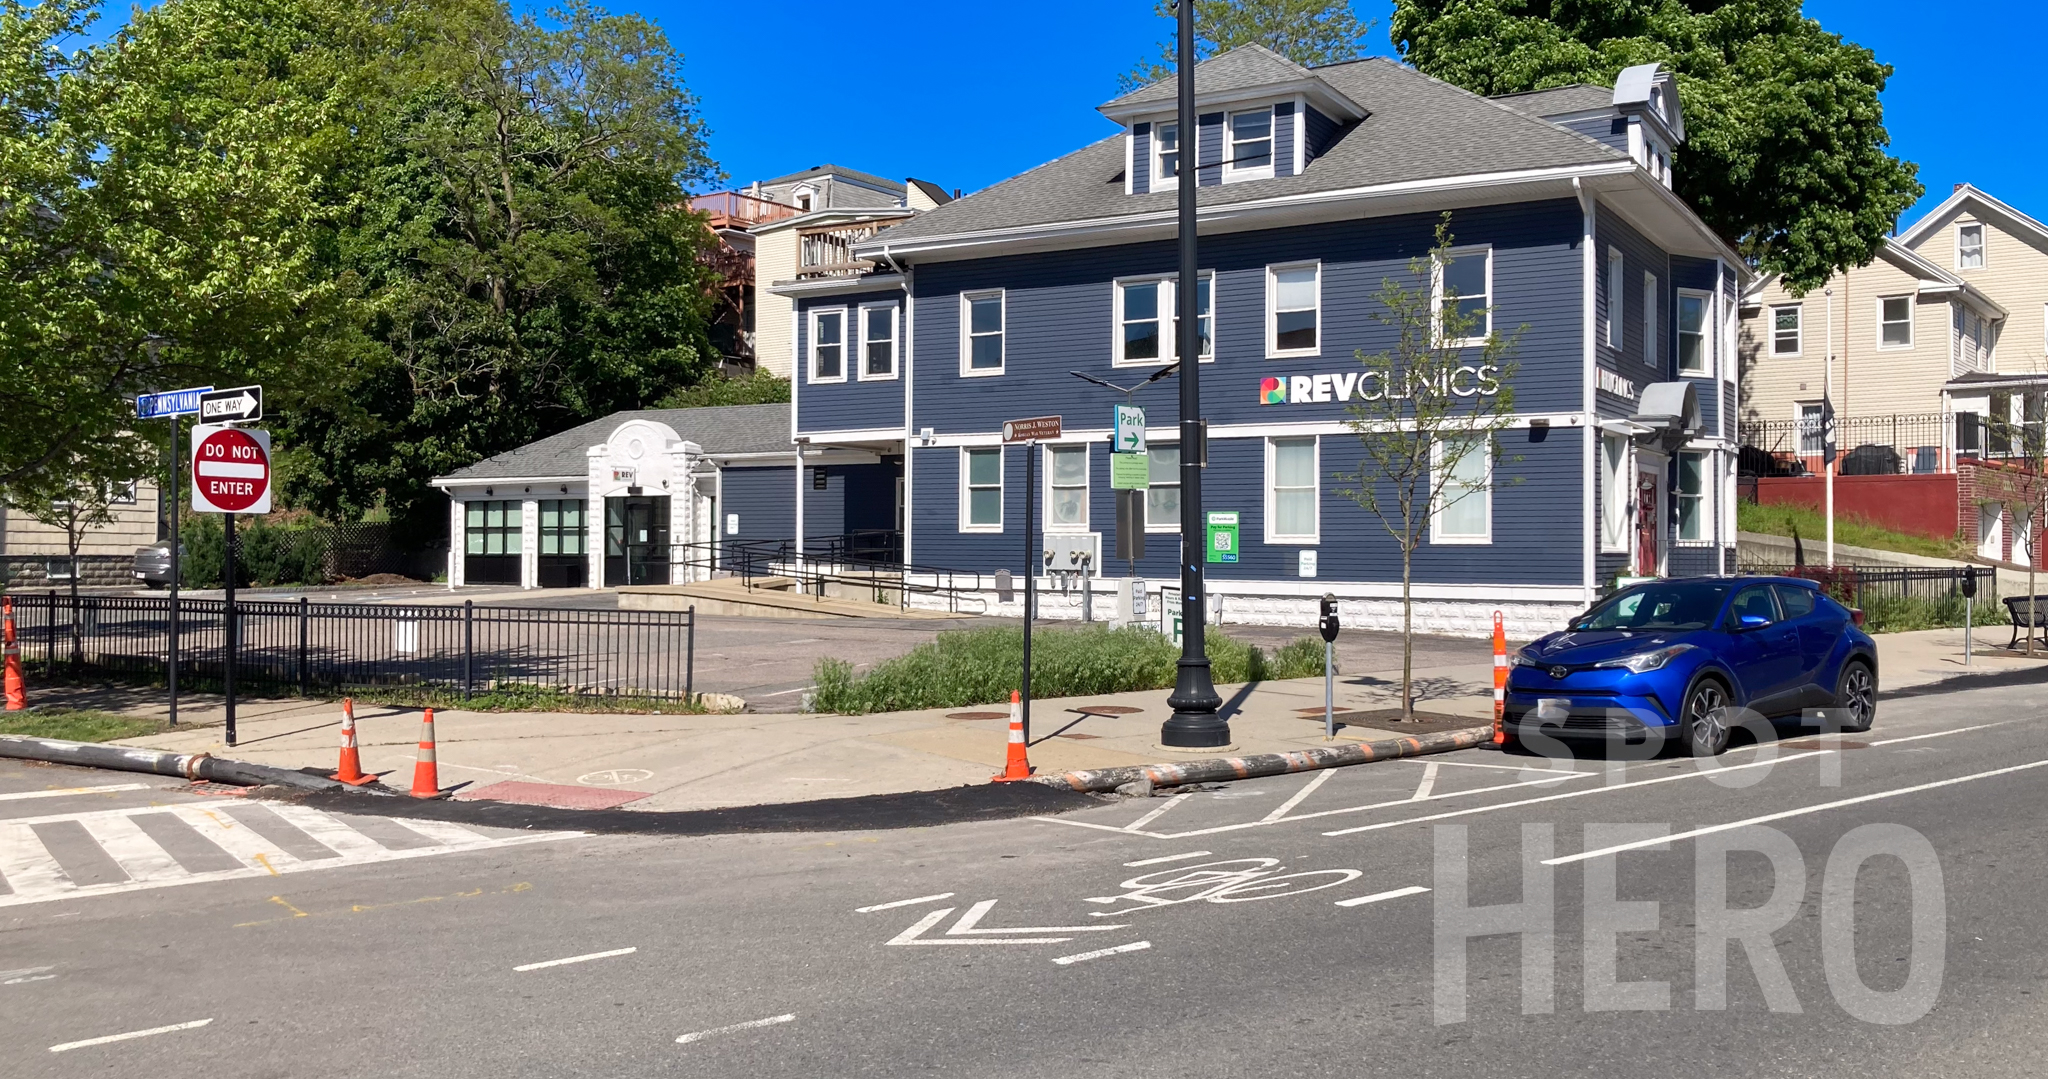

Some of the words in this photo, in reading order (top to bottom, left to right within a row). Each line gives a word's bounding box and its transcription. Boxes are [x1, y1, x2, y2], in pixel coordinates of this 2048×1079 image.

[150, 391, 200, 415] PENNSYLVANIA
[205, 401, 222, 415] ONE
[225, 399, 243, 412] WAY
[1014, 422, 1031, 430] NORRIS
[1032, 421, 1037, 429] J.
[1037, 420, 1059, 428] WESTON
[1120, 412, 1143, 427] Park
[205, 443, 225, 457] DO
[232, 445, 258, 459] NOT
[210, 481, 253, 496] ENTER
